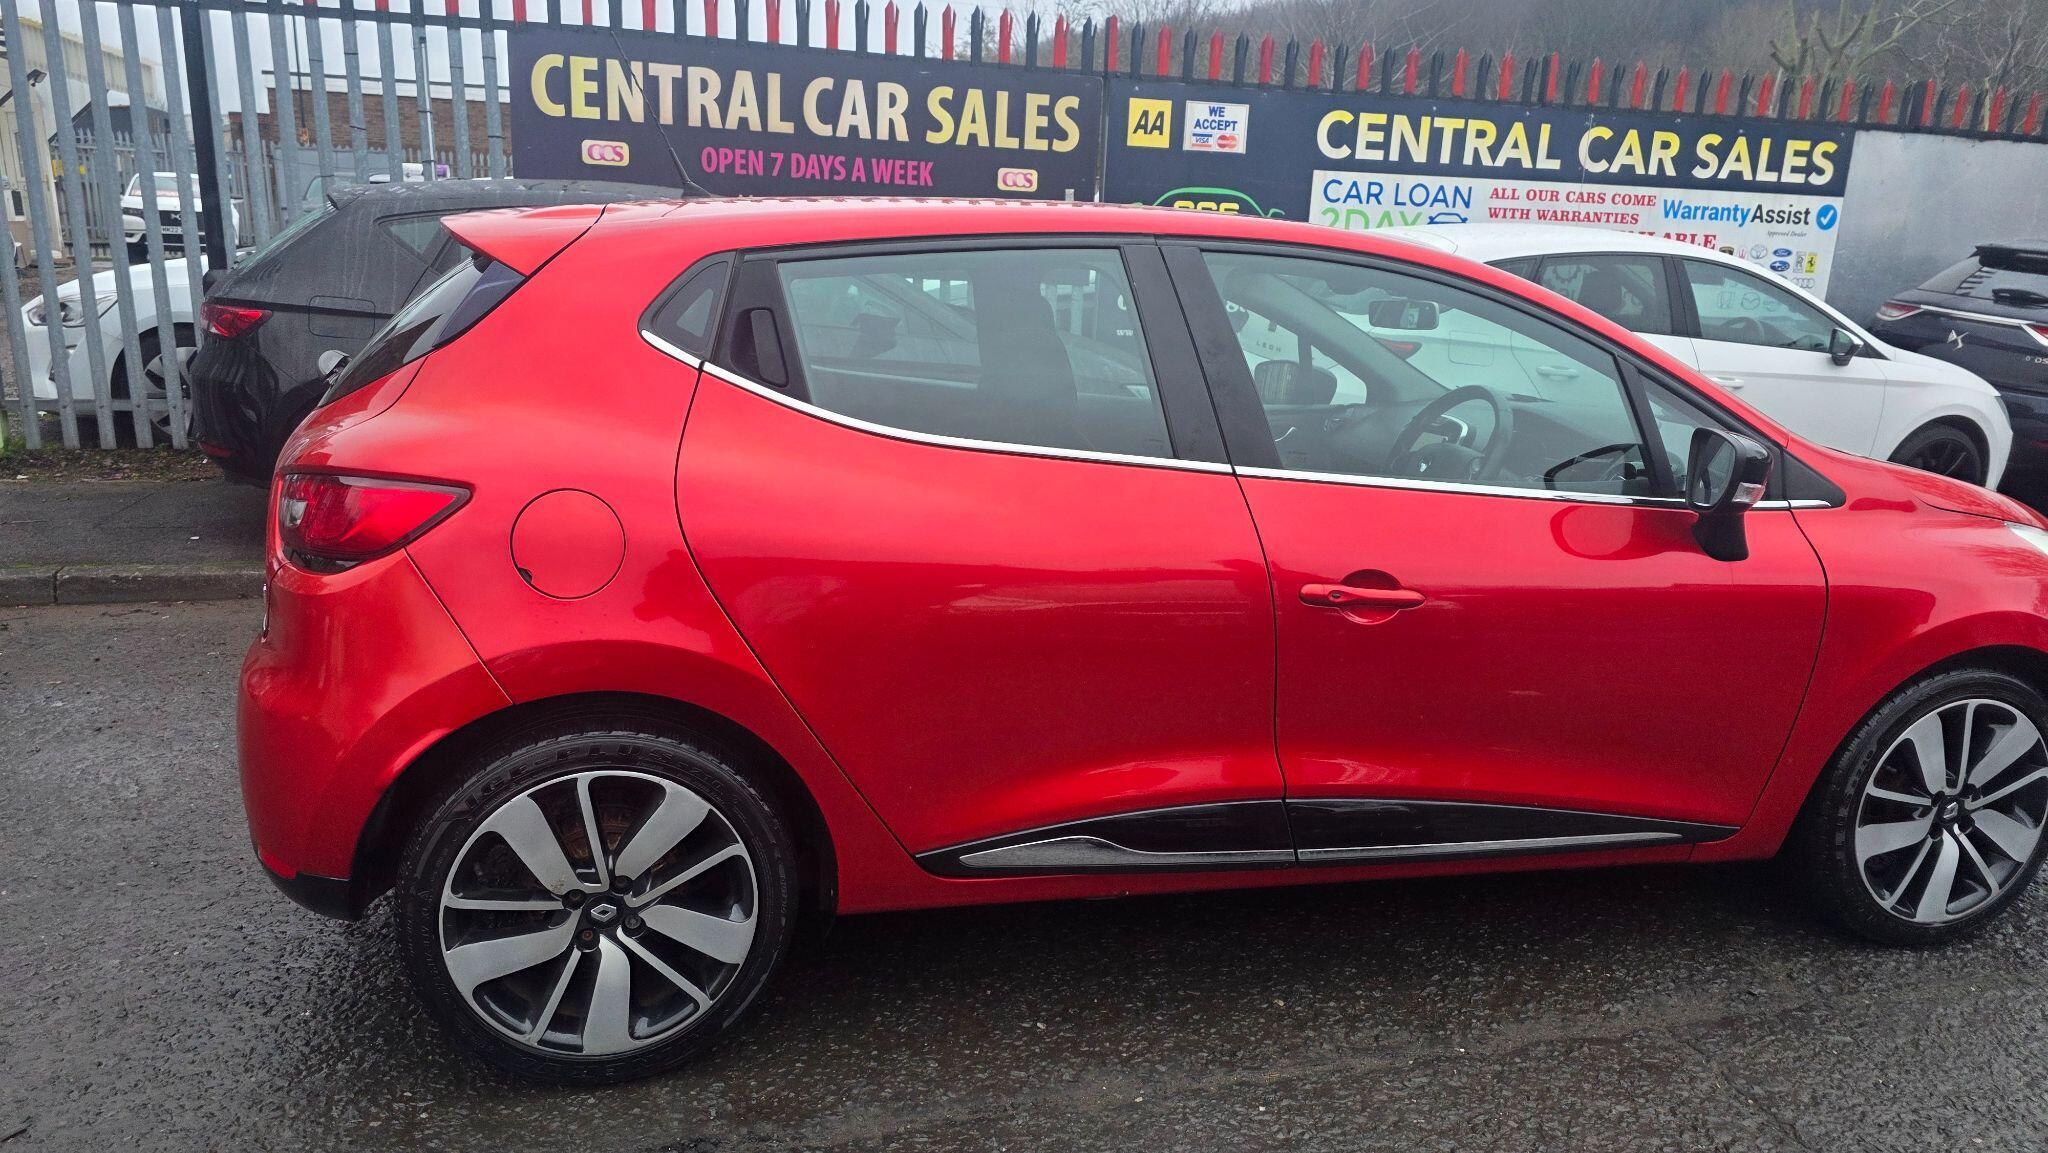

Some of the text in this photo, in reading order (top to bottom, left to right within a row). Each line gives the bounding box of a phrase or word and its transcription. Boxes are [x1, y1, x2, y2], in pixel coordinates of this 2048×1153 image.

[531, 54, 1080, 152] CENTRAL CAR SALES
[1209, 105, 1226, 118] WE
[1132, 109, 1165, 136] AA
[1193, 118, 1238, 132] ACCEPT
[1316, 110, 1838, 186] CENTRAL CAR SALES
[701, 147, 934, 187] OPEN 7 DAYS A WEEK
[1323, 179, 1472, 209] CAR LOAN
[1489, 187, 1657, 207] ALL OUR CARS COME
[1488, 207, 1640, 225] WITH WARRANTIES
